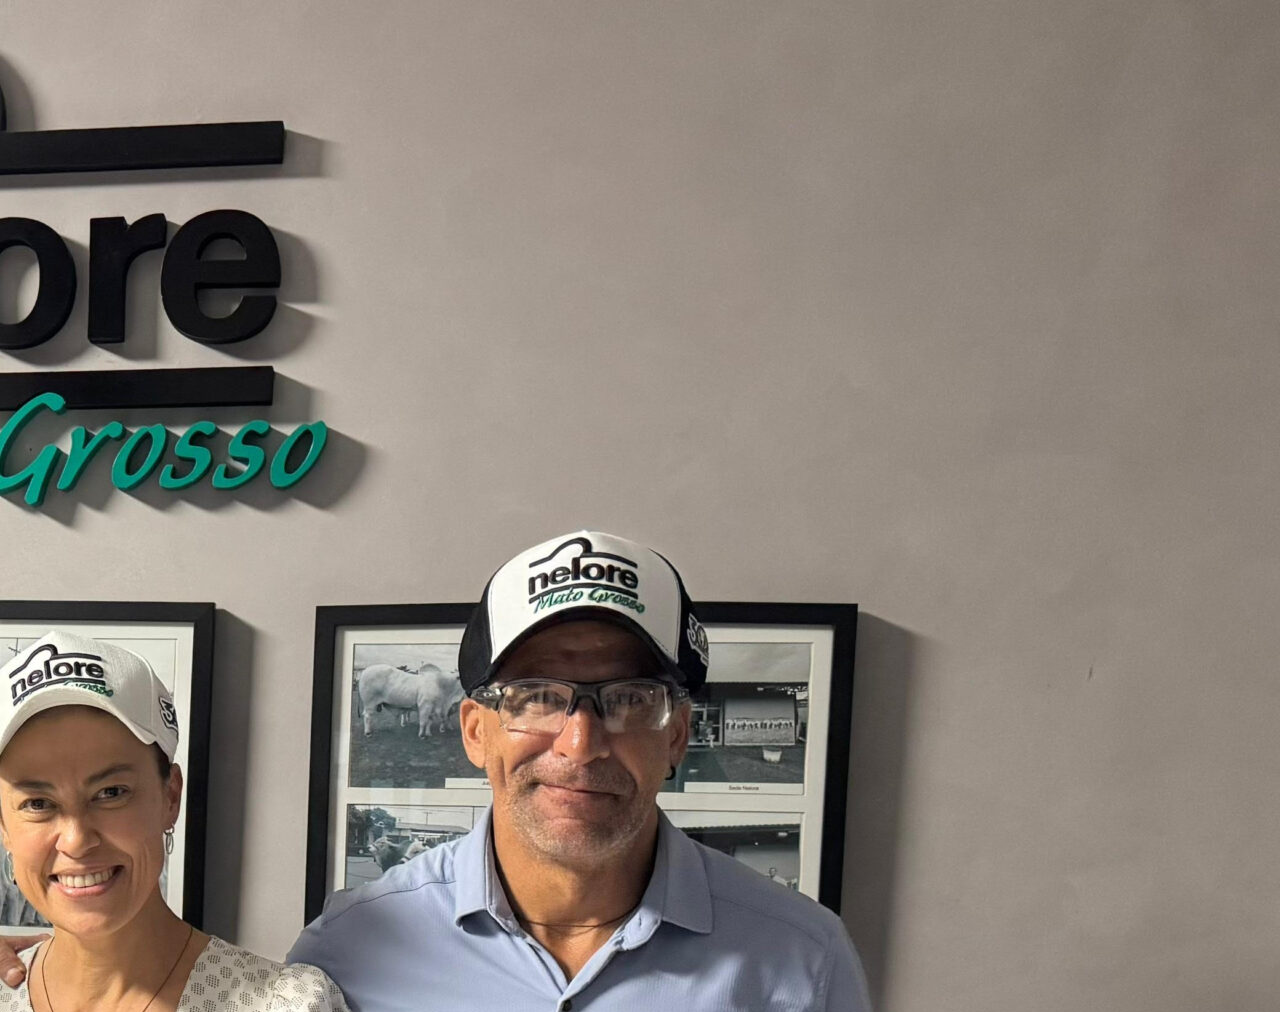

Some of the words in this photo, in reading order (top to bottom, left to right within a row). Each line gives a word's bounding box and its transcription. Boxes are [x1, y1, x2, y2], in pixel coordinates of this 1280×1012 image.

[528, 557, 639, 595] nelore
[534, 587, 583, 614] Mato
[588, 586, 645, 613] Grosso
[11, 659, 104, 700] nelore
